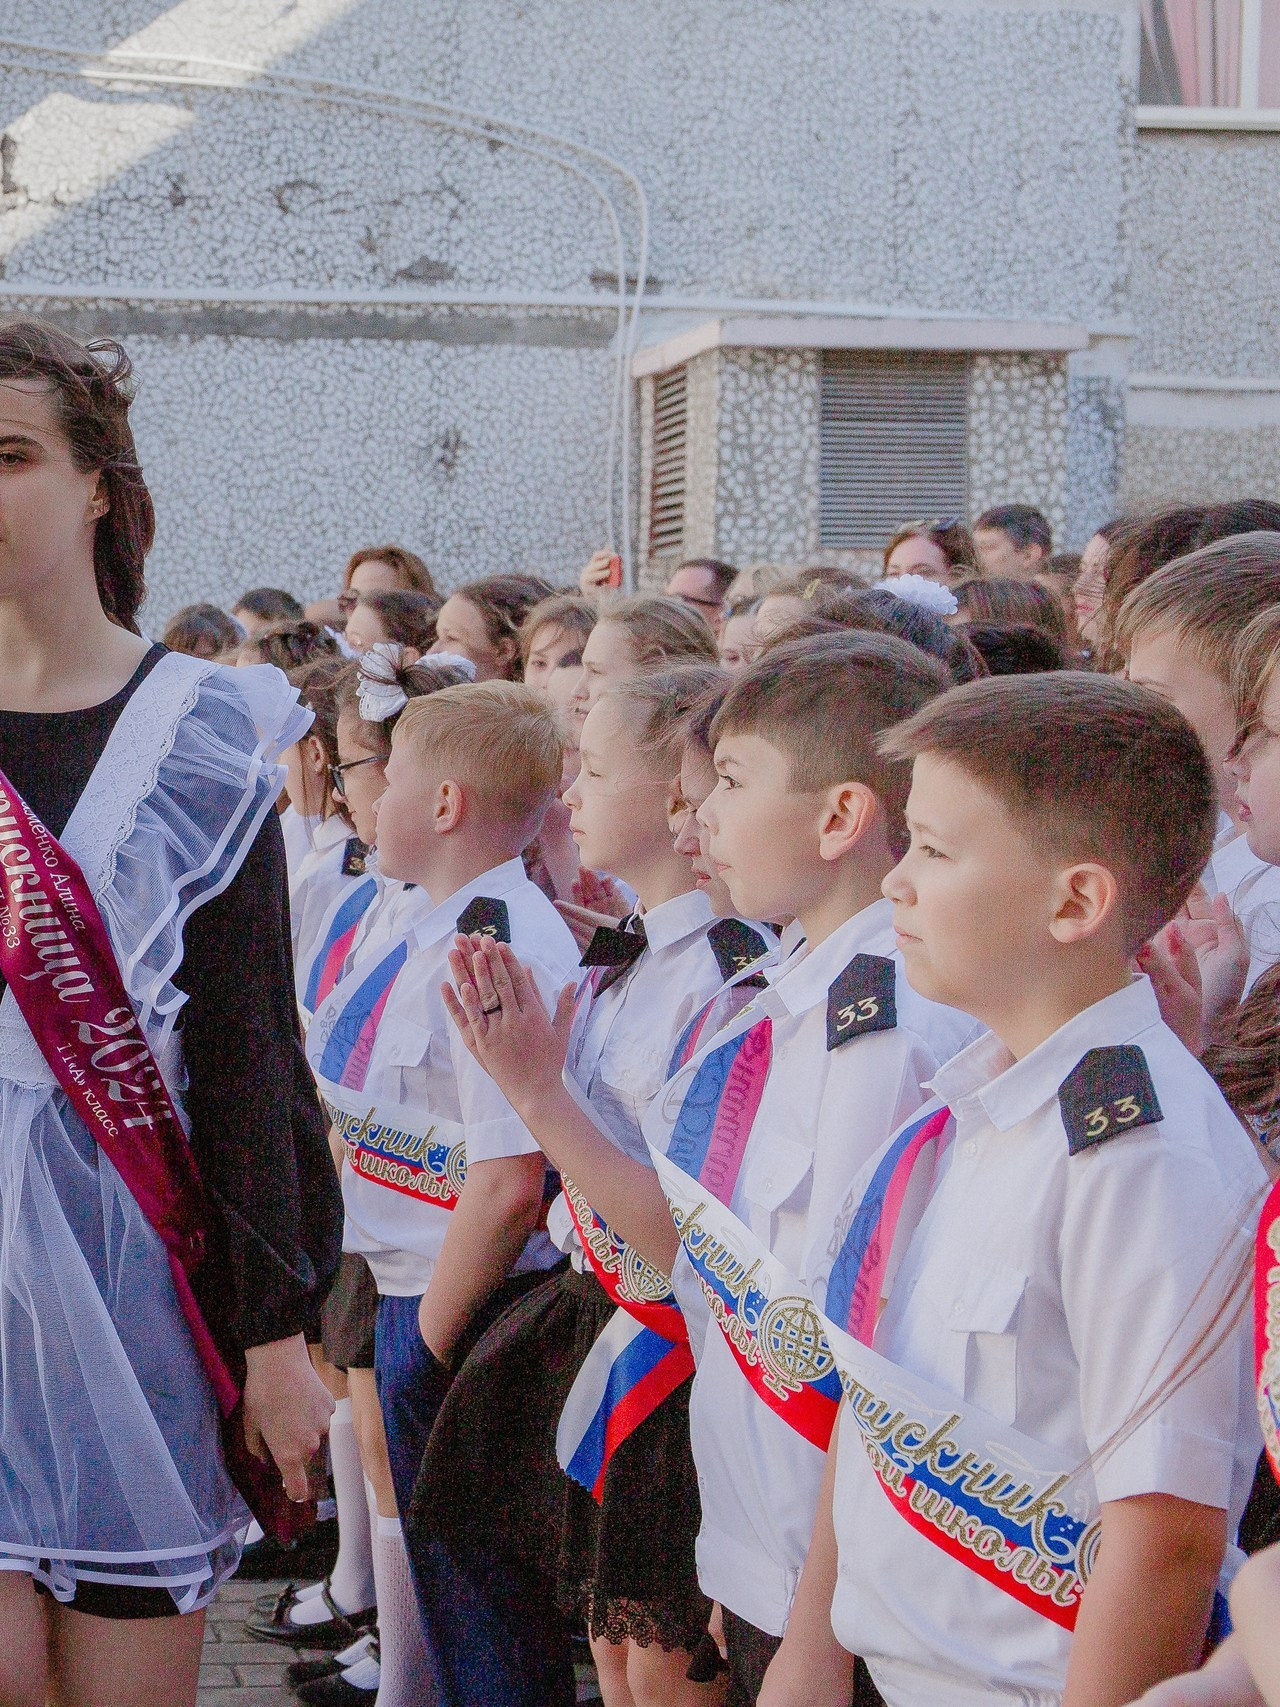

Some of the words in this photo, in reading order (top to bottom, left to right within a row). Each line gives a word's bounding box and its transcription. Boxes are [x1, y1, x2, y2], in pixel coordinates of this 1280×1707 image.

[17, 794, 59, 868] менко
[50, 872, 86, 931] Алина
[71, 1007, 173, 1130] 2024
[837, 996, 879, 1032] 33
[57, 1042, 86, 1086] 11«А»
[82, 1088, 119, 1137] класс
[359, 1150, 452, 1201] школы
[667, 1197, 764, 1331] скник
[695, 1269, 757, 1366] колы
[909, 1480, 1078, 1607] школы
